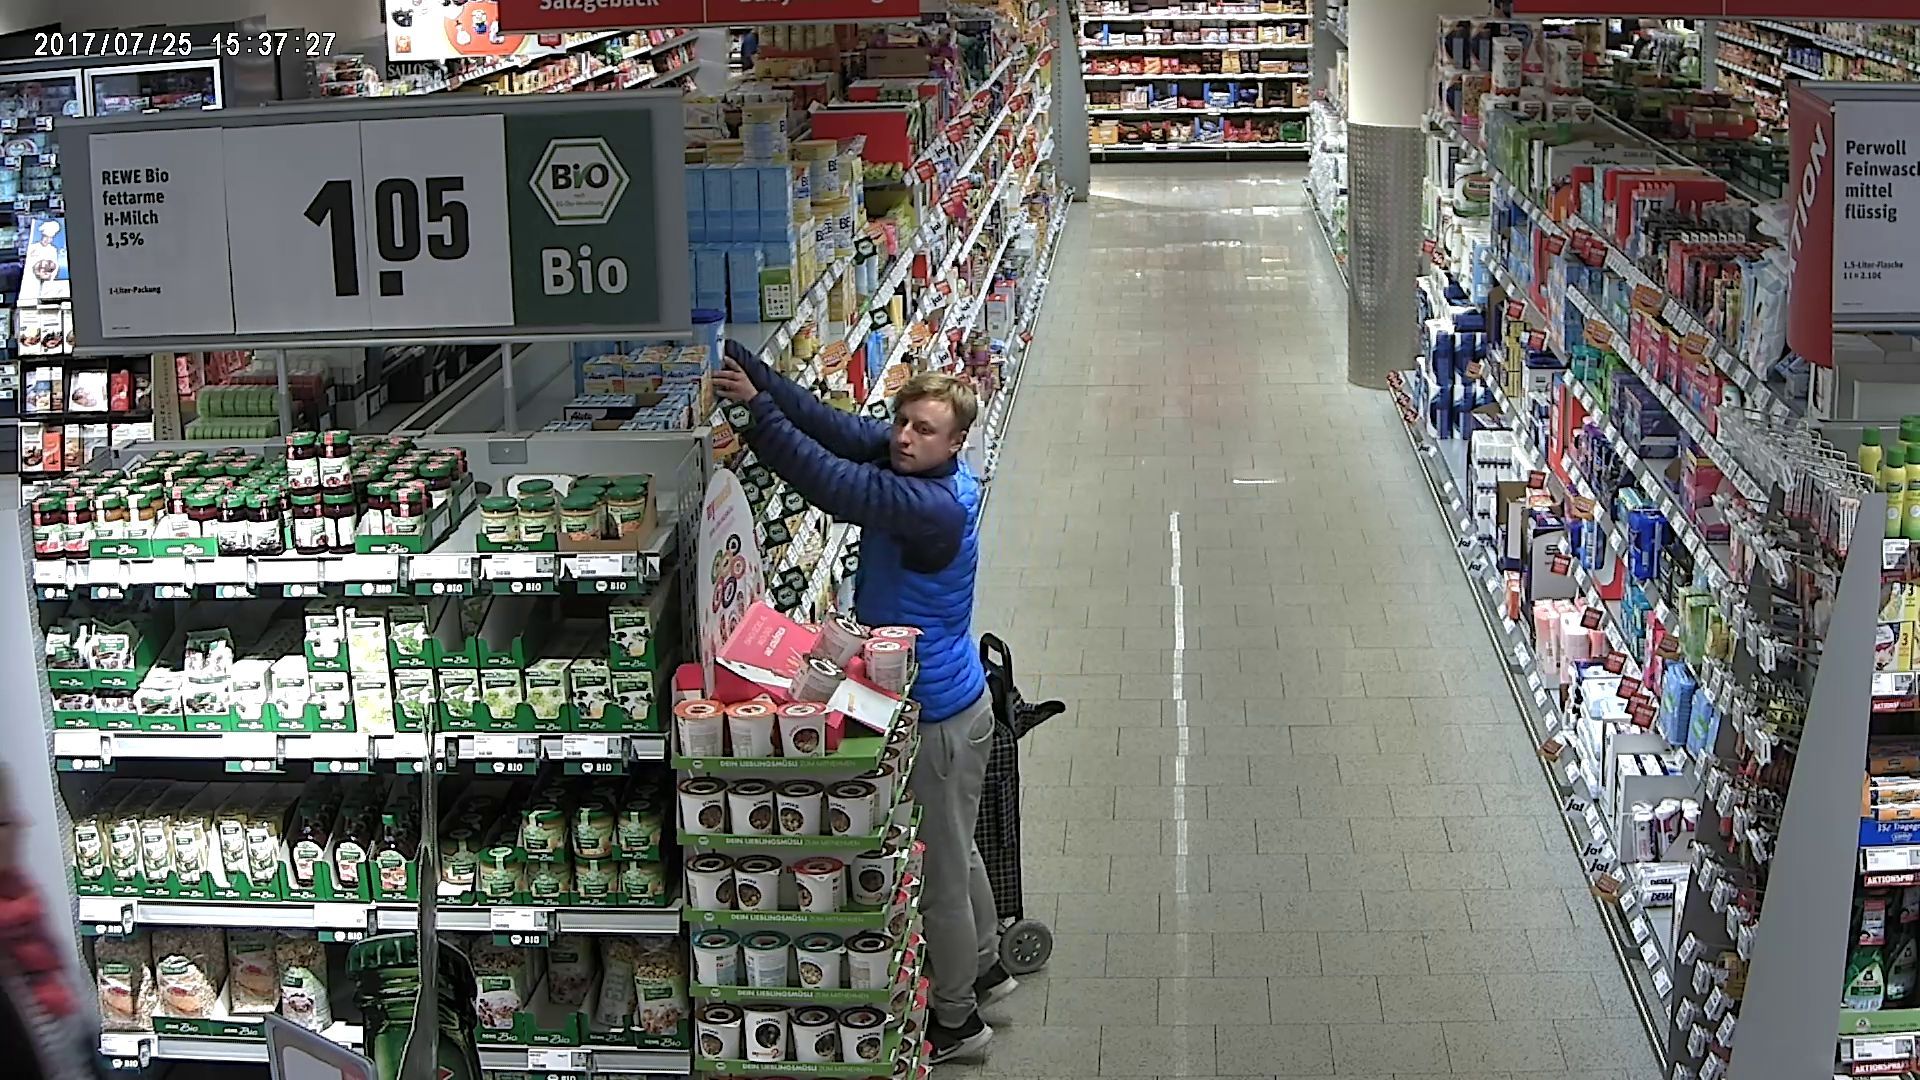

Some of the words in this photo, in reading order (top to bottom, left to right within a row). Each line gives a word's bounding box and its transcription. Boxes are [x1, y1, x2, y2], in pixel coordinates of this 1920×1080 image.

[1845, 140, 1907, 156] Perwoll
[102, 170, 142, 185] REWE
[145, 167, 170, 183] Bio
[1845, 183, 1893, 198] mittel
[103, 191, 165, 206] fettarme
[104, 209, 159, 226] H-Milch
[1845, 204, 1898, 223] flüssig
[105, 232, 145, 249] 1,5%
[541, 243, 629, 296] Bio
[525, 582, 542, 592] BIO
[610, 582, 627, 591] BIO
[507, 762, 523, 772] BIO
[595, 762, 612, 772] BIO
[525, 935, 540, 945] BIO
